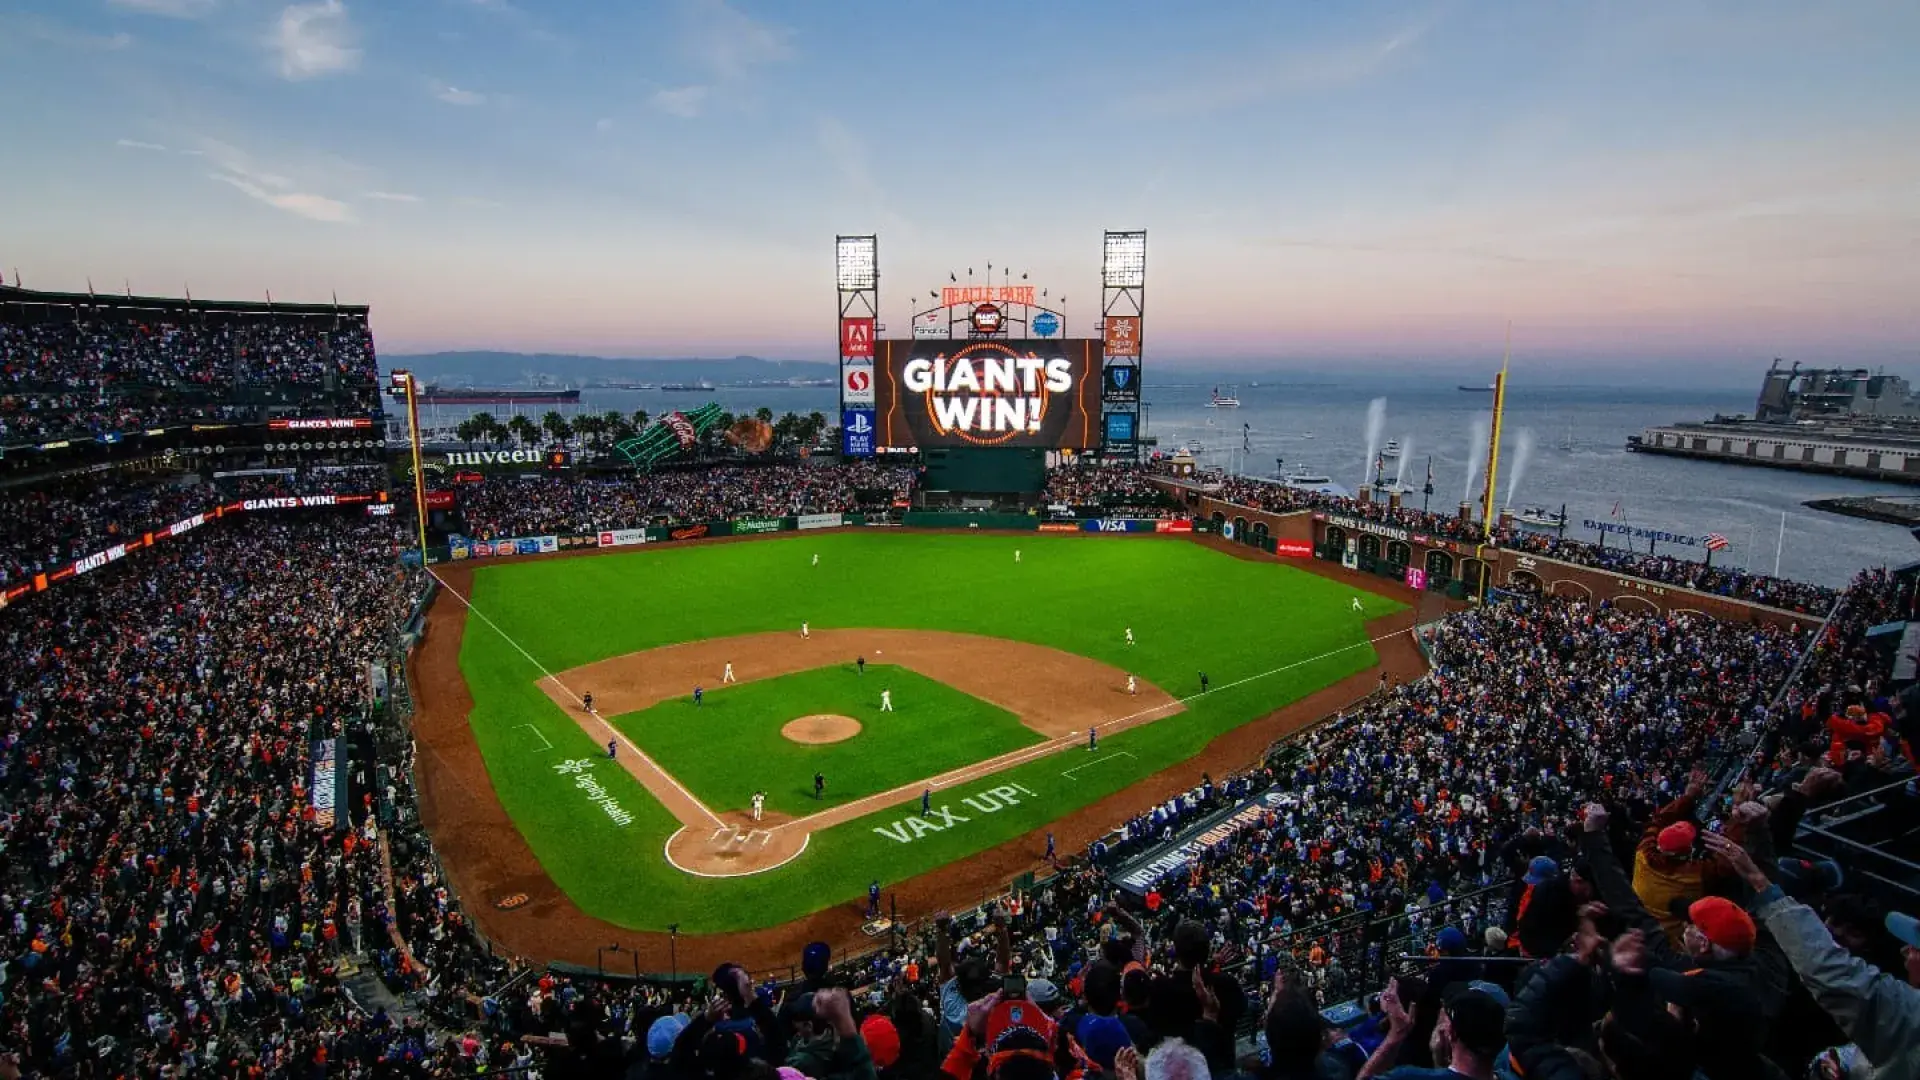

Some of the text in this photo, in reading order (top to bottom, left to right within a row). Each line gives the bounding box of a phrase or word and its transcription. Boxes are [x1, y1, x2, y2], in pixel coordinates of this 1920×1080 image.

[943, 287, 1035, 307] ORACLE PARK
[904, 358, 1072, 393] GIANTS
[288, 419, 328, 428] GIANTS
[933, 397, 1041, 431] WIN!
[447, 450, 542, 465] nuveen
[243, 495, 336, 510] GIANTS WIN!
[170, 519, 193, 536] GIANTS
[1096, 519, 1127, 531] VISA
[1358, 521, 1408, 541] LANDING
[1636, 527, 1696, 546] AMERICA
[75, 551, 106, 575] GIANTS
[576, 773, 636, 826] Dignity Health
[872, 782, 1038, 843] VAX UP!
[1122, 850, 1190, 888] WELCOME
